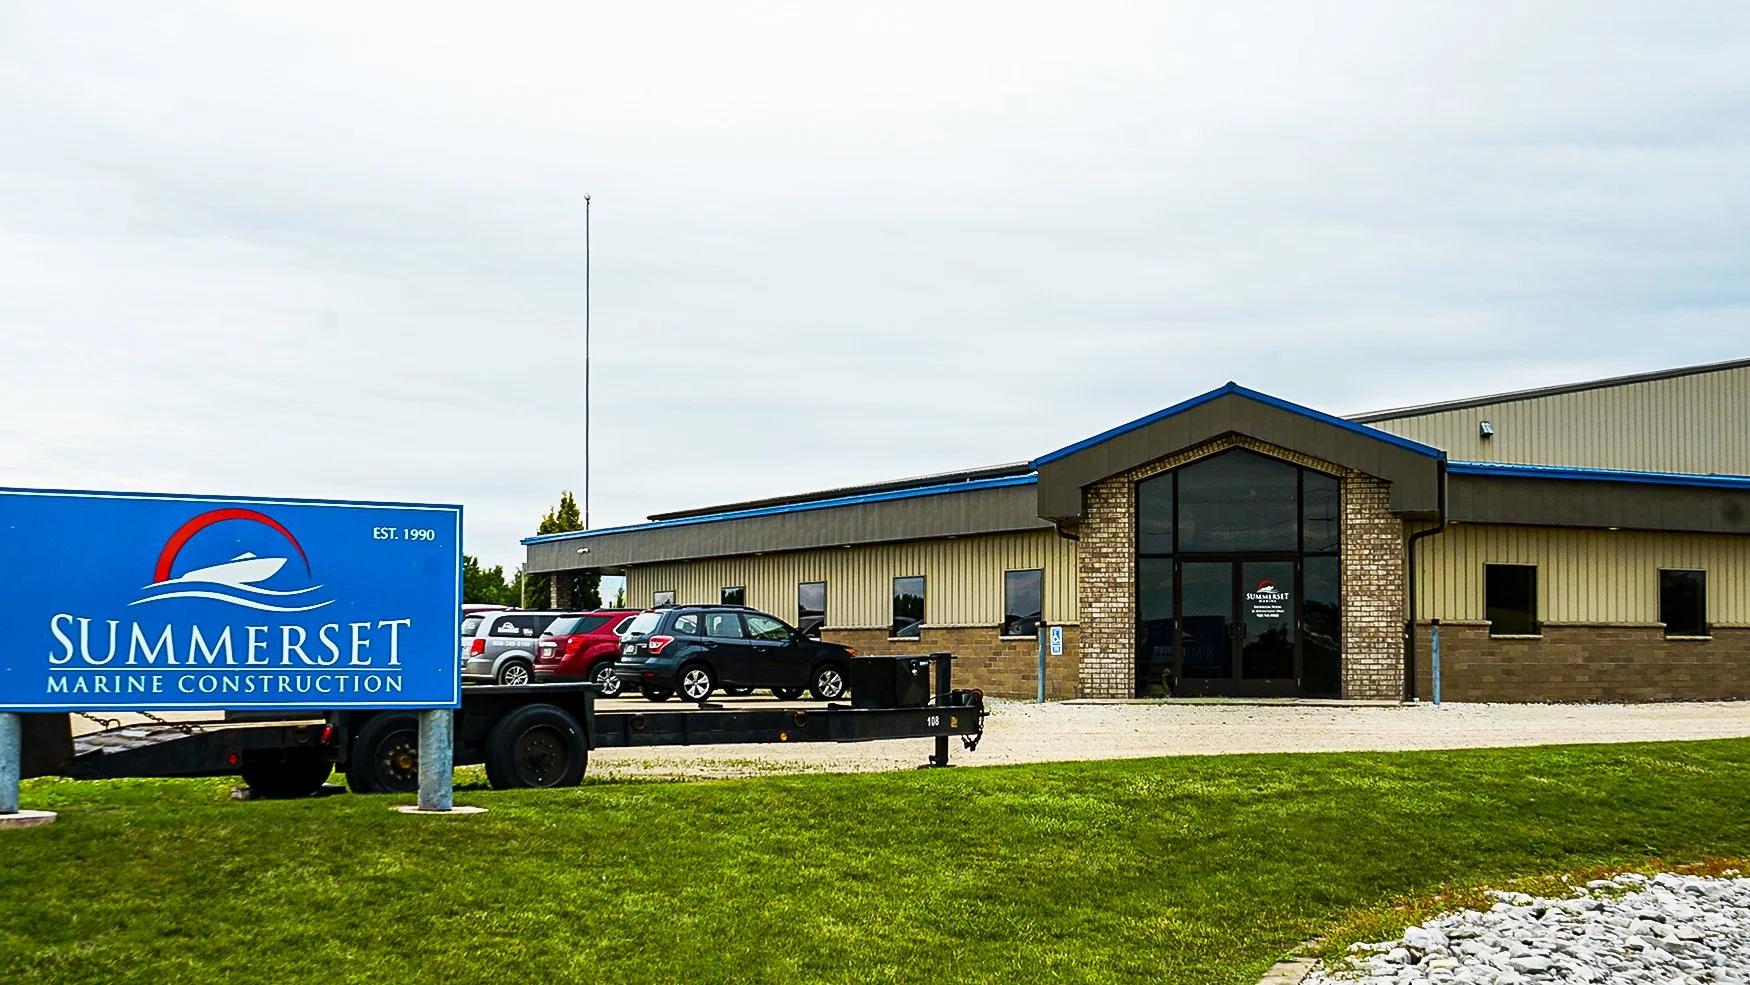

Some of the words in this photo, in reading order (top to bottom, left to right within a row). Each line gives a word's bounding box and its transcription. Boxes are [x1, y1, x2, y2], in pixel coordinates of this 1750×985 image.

[374, 527, 398, 539] EST.
[404, 529, 434, 540] 1990
[1246, 592, 1290, 600] SUMMERSET
[48, 613, 411, 666] SUMMERSET
[47, 676, 162, 692] MARINE
[179, 676, 401, 692] CONSTRUCTION
[927, 715, 939, 726] 108
